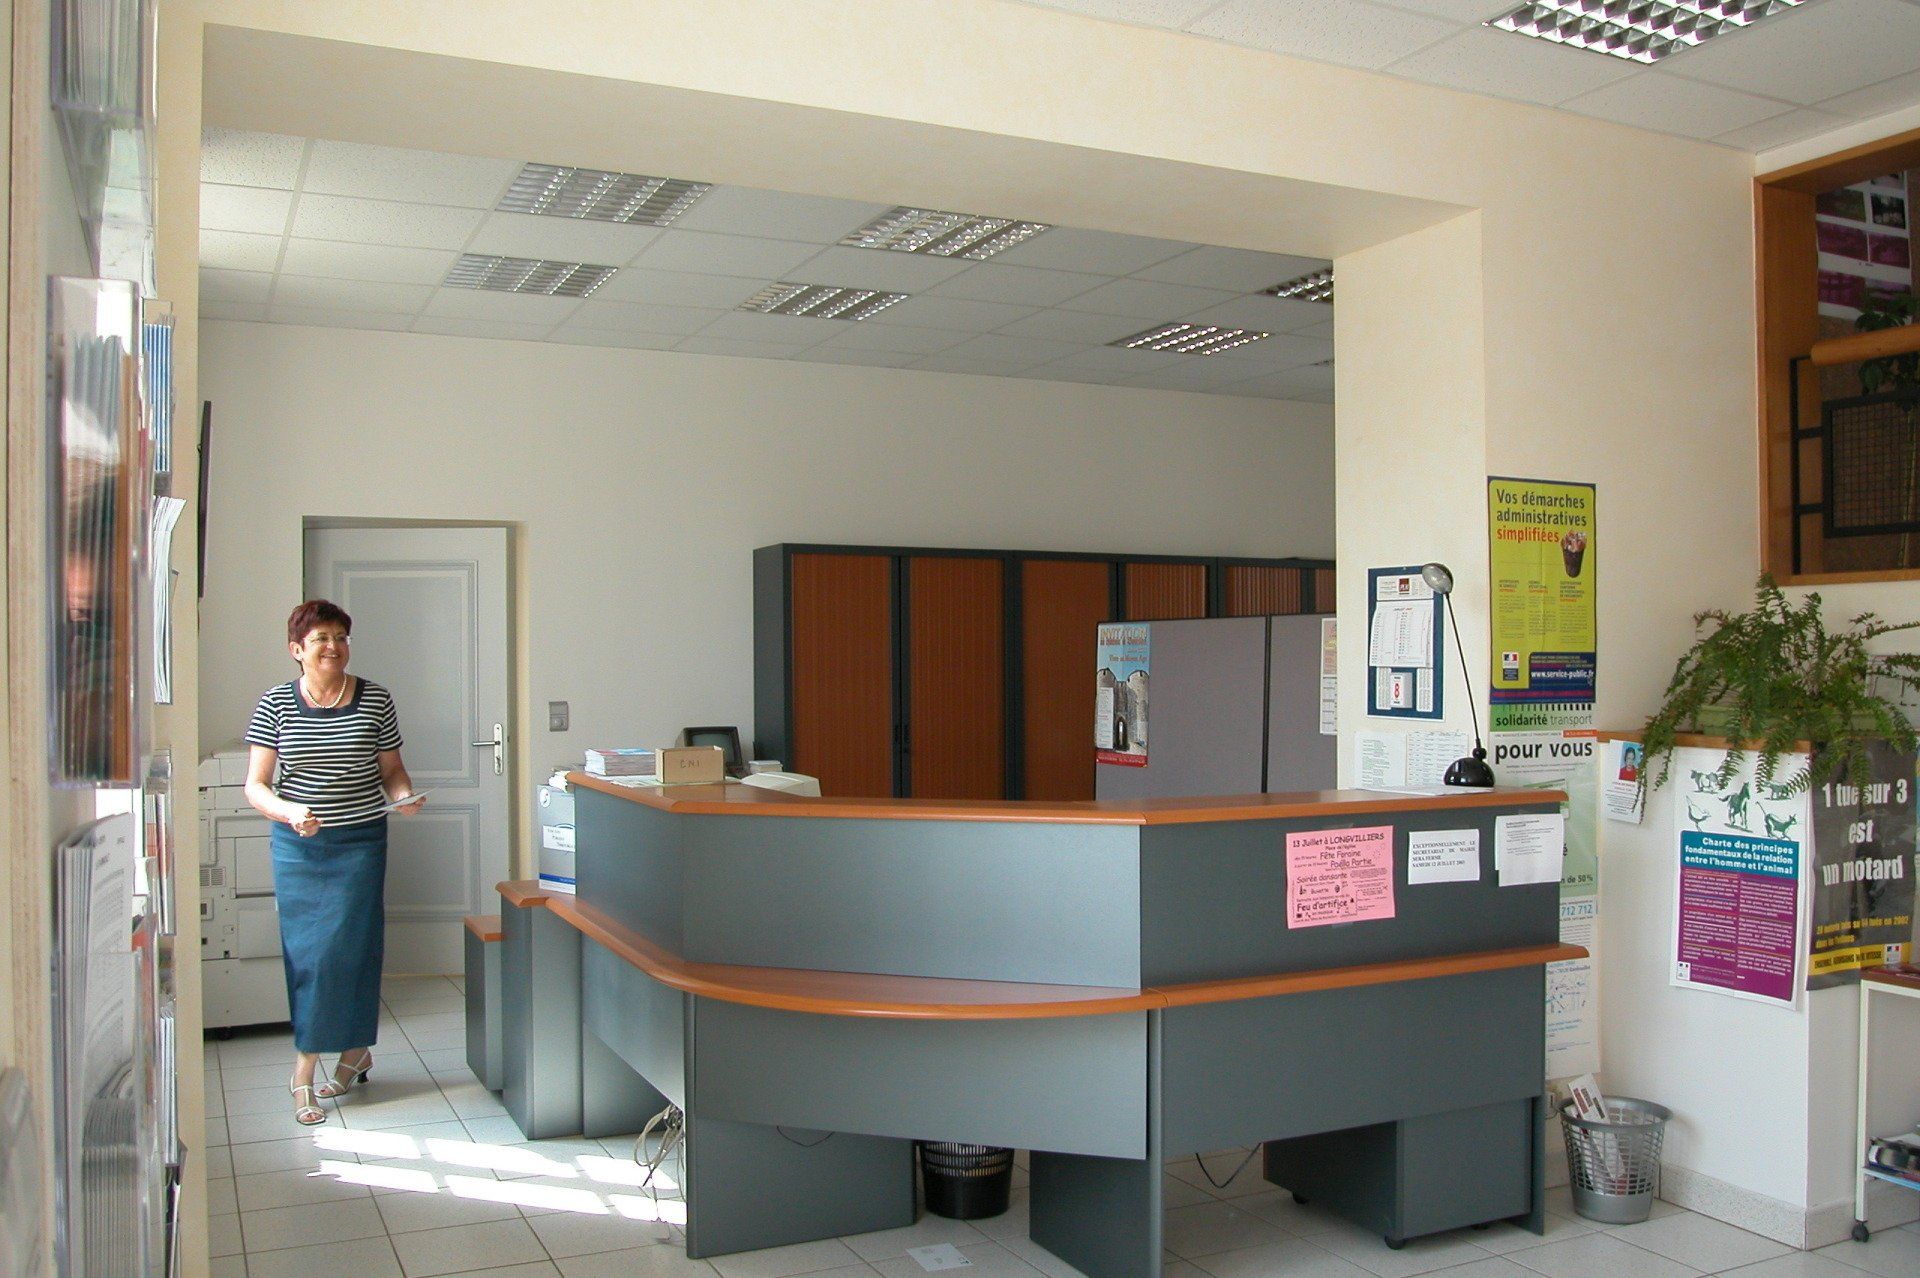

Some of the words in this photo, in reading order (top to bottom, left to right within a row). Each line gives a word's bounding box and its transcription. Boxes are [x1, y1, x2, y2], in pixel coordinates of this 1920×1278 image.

[1496, 488, 1518, 505] Vos
[1521, 490, 1585, 509] démarches
[1496, 508, 1587, 527] administratives
[1496, 525, 1560, 543] simplifiées
[1531, 669, 1594, 679] www.service-public.fr
[1394, 683, 1400, 698] 8
[1496, 714, 1548, 726] solidarité
[1550, 714, 1592, 727] transport
[1495, 743, 1542, 764] pour
[1549, 742, 1592, 757] vous
[1822, 782, 1831, 808] 1
[1863, 782, 1891, 805] sur
[1896, 778, 1908, 804] 3
[1293, 840, 1301, 848] 13
[1302, 837, 1323, 848] Juillet
[1324, 836, 1329, 846] à
[1330, 833, 1385, 845] LONGVILLIERS
[1848, 819, 1874, 844] est
[1413, 841, 1466, 849] EXCEPTIONNELLEMENT
[1702, 837, 1732, 848] Charte
[1734, 841, 1750, 849] des
[1752, 843, 1794, 855] principes
[1320, 851, 1336, 860] Fête
[1337, 850, 1362, 859] Foraine
[1685, 845, 1740, 858] fondamentaux
[1742, 851, 1752, 860] de
[1753, 853, 1760, 861] la
[1761, 854, 1793, 865] relation
[1685, 856, 1708, 865] entre
[1709, 857, 1747, 869] l'homme
[1748, 863, 1757, 871] et
[1758, 863, 1793, 875] l'animal
[1843, 855, 1904, 883] motard
[1297, 874, 1318, 884] Soirée
[1319, 872, 1348, 881] dansante
[1297, 902, 1311, 913] Feu
[1313, 899, 1348, 910] d'artifice
[1562, 906, 1575, 916] 712
[1578, 905, 1592, 914] 712
